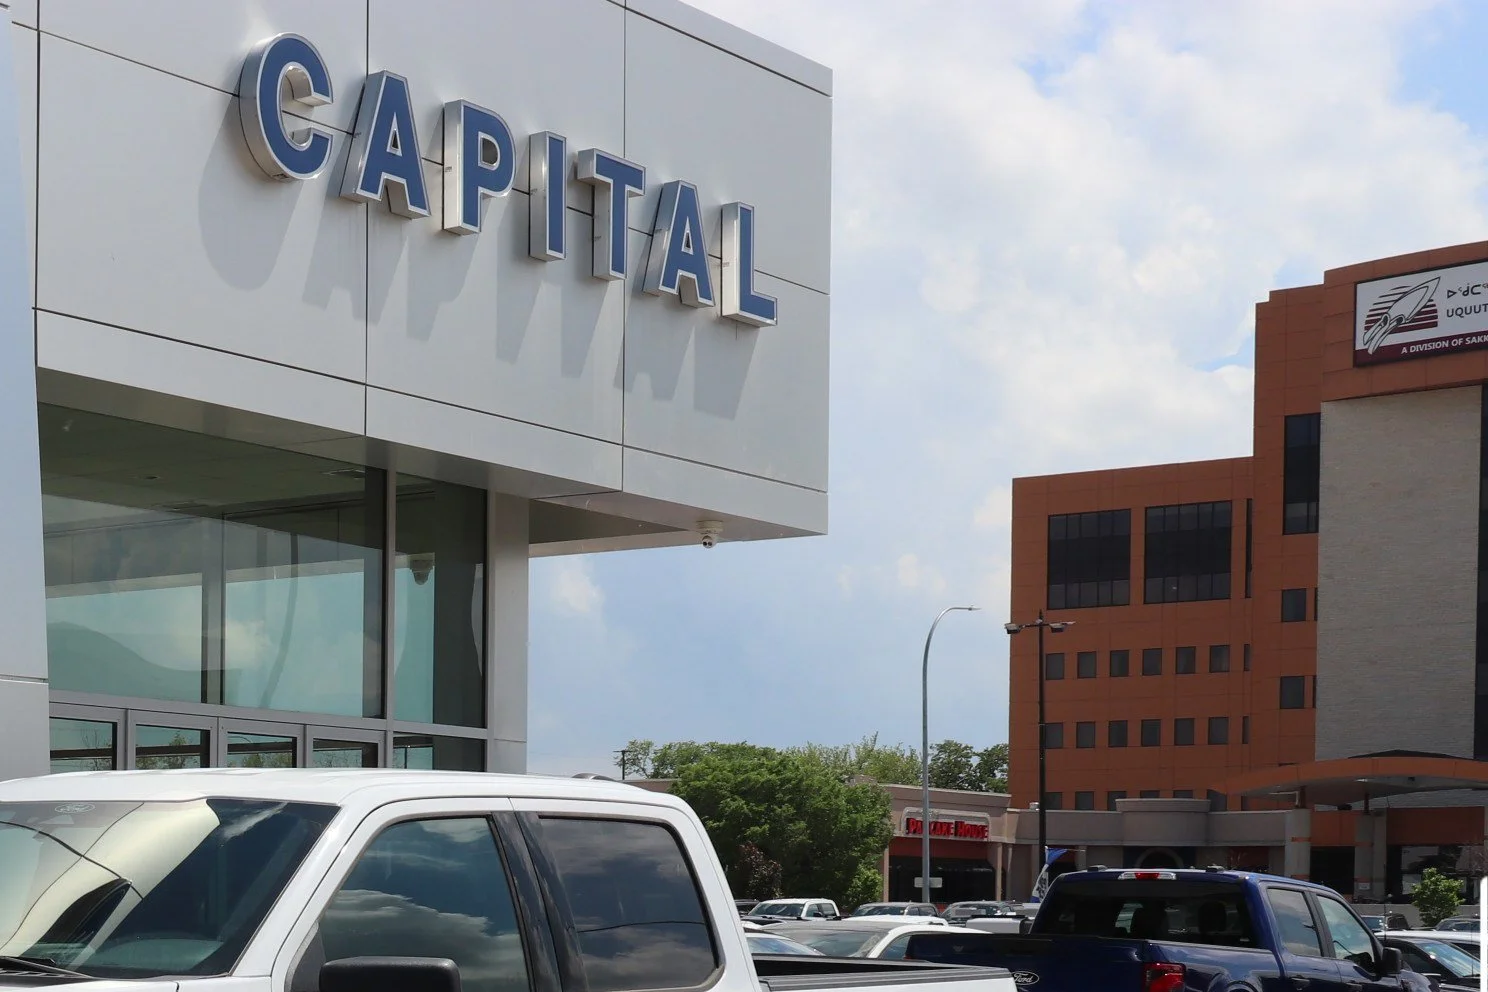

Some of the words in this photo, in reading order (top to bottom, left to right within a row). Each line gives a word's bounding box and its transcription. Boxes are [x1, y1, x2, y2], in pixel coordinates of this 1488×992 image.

[239, 33, 778, 328] CAPITAL
[1401, 346, 1408, 355] A
[1409, 340, 1449, 353] DIVISION
[1451, 337, 1463, 346] OF
[906, 818, 954, 836] PACAKE
